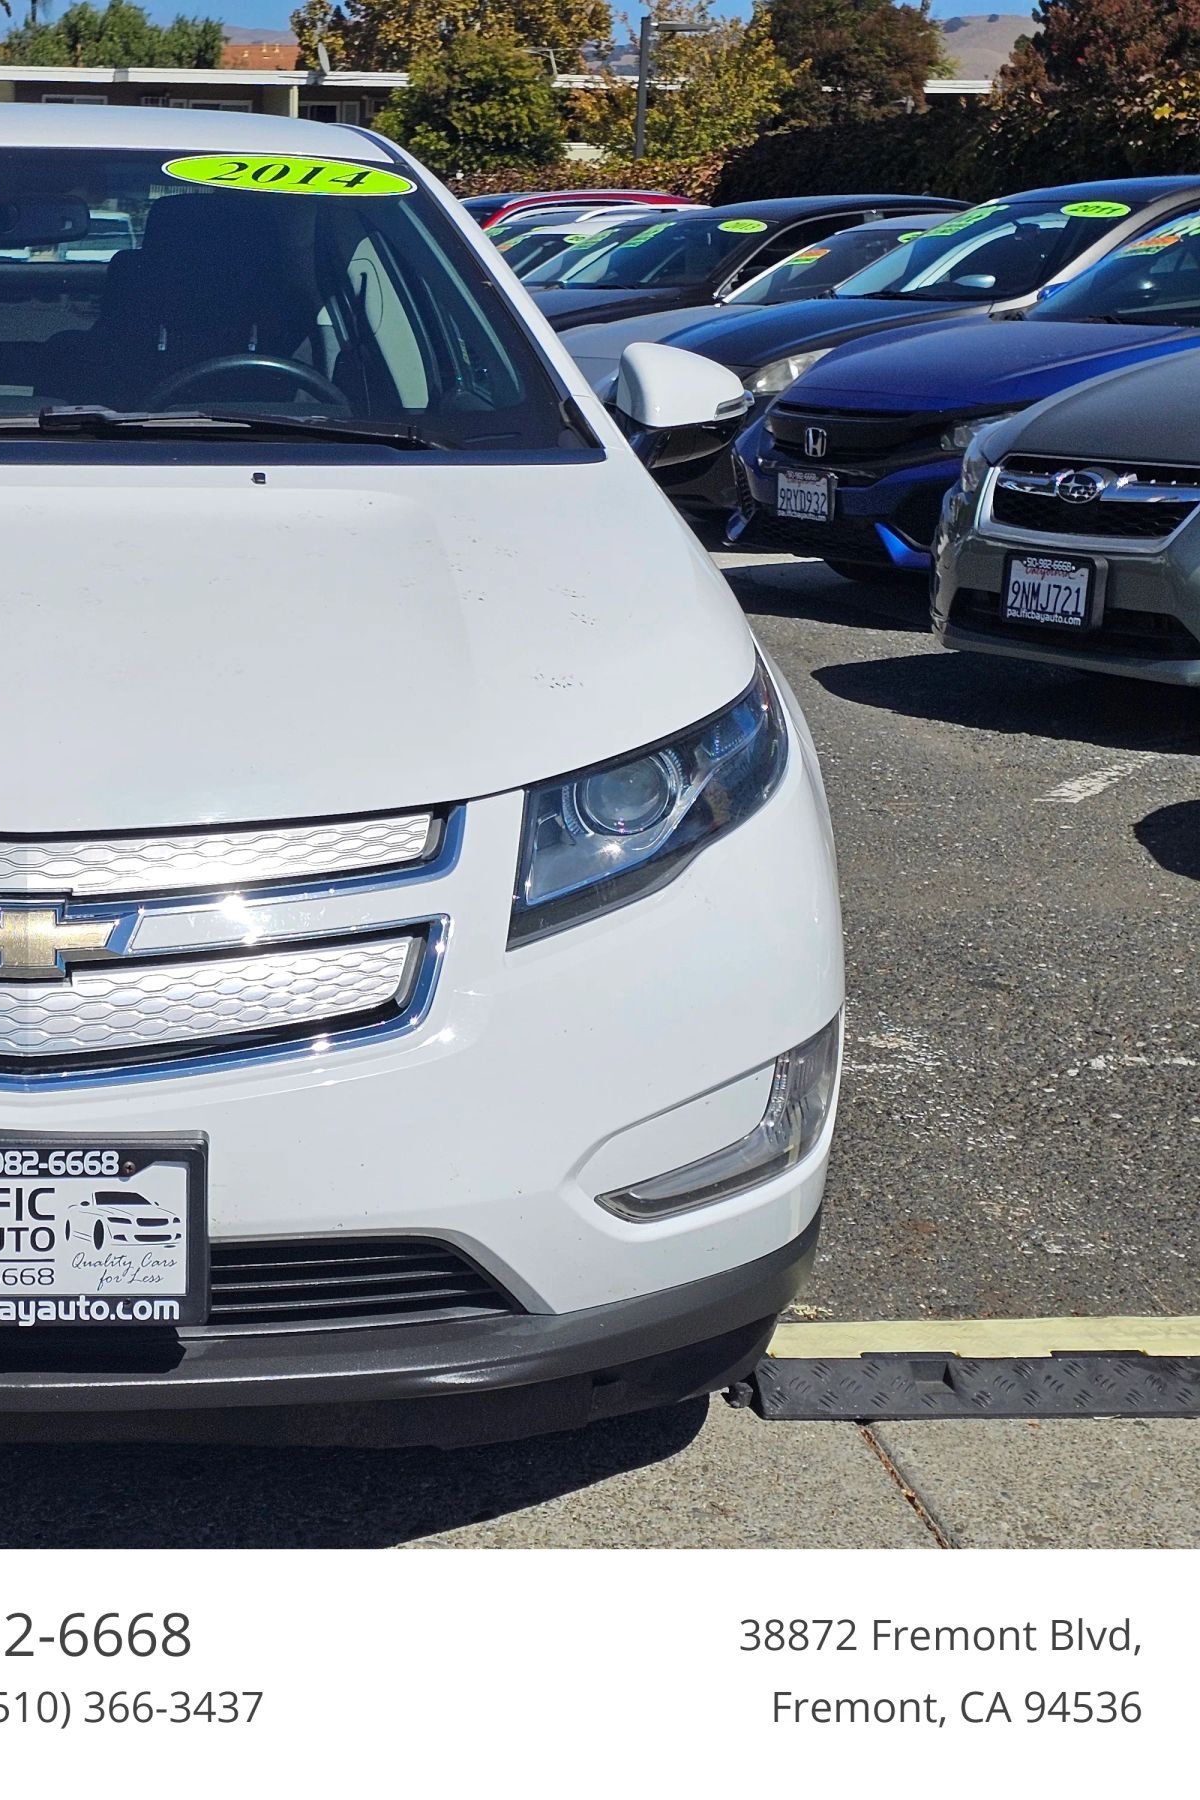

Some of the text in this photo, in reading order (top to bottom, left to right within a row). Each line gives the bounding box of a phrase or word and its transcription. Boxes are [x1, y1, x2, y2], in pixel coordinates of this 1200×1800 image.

[207, 161, 371, 188] 2014
[780, 487, 827, 516] 9RYD932
[1026, 557, 1072, 572] 510-982-6668
[1010, 580, 1083, 617] 9NMJ721
[1006, 607, 1082, 627] pacificbayauto.com
[71, 1251, 179, 1277] Quality Cars
[97, 1266, 164, 1292] for Less
